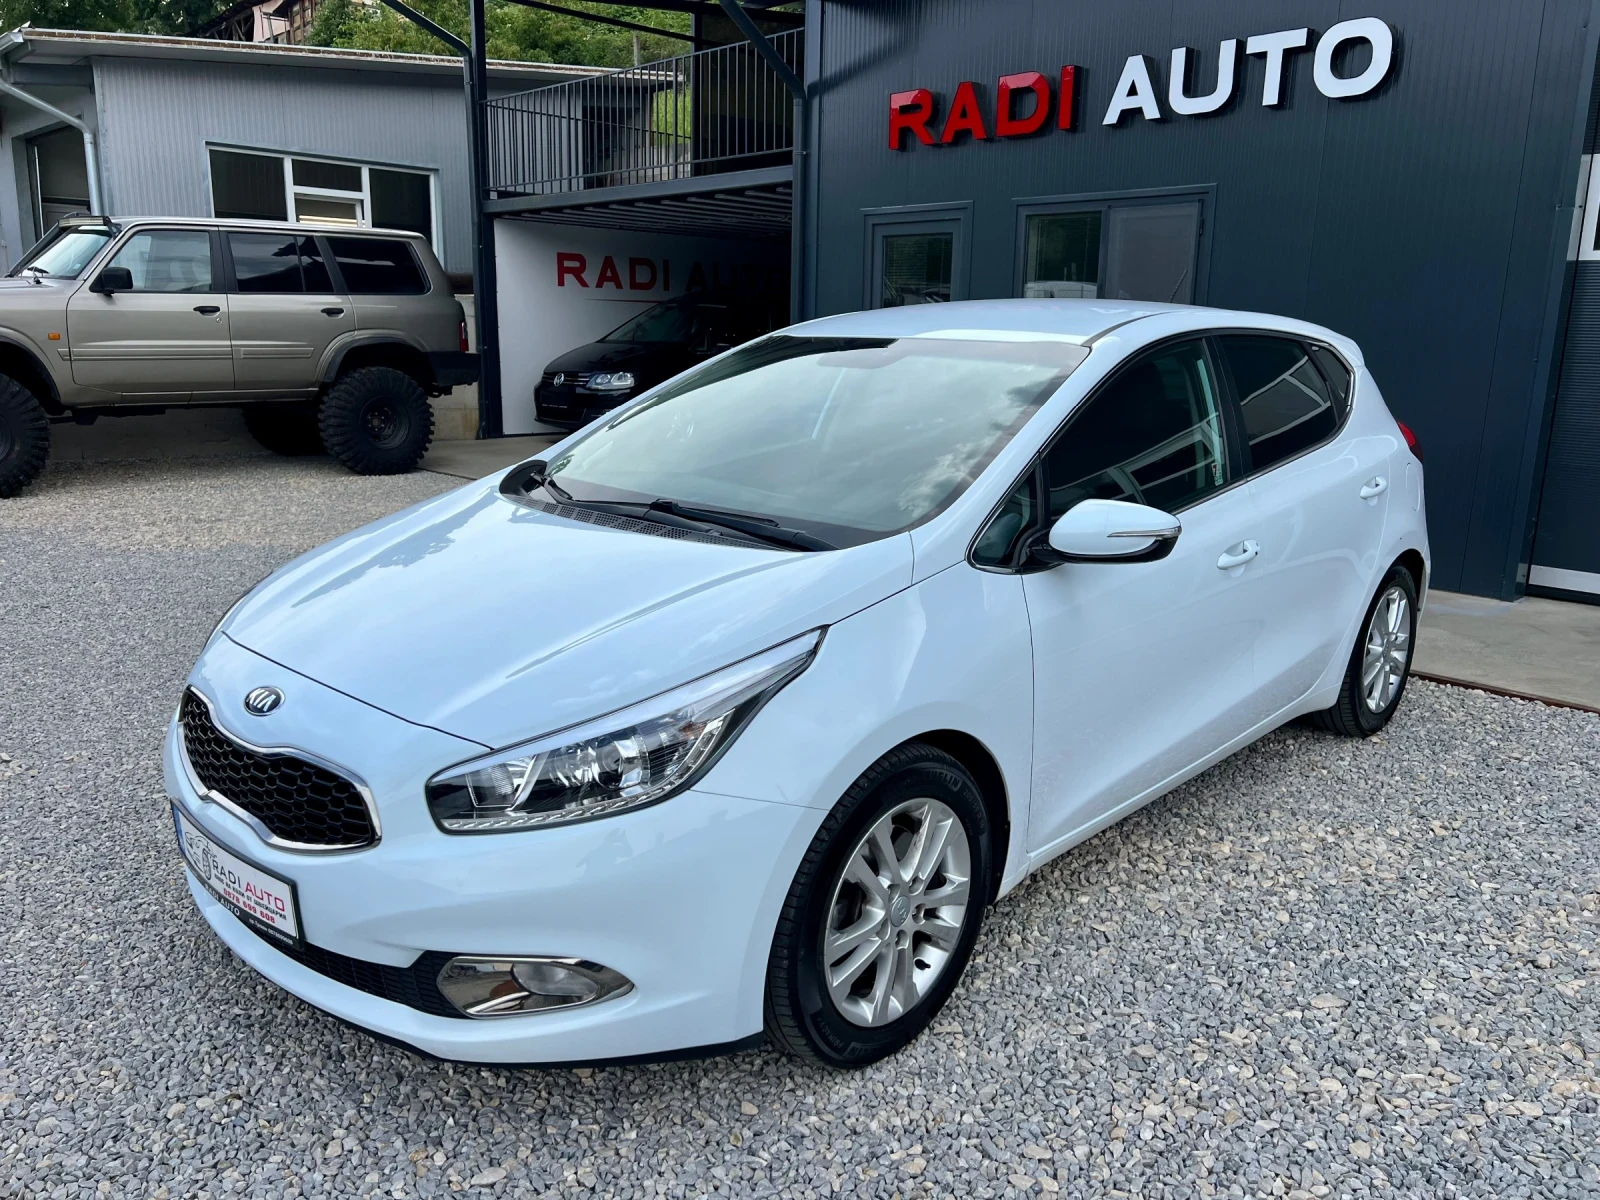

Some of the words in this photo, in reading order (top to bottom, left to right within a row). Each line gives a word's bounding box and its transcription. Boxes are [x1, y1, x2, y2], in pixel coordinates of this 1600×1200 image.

[888, 64, 1077, 151] RADI
[1102, 16, 1394, 127] AUTO
[556, 251, 671, 292] RADI
[204, 882, 219, 901] RADI
[220, 898, 240, 916] AUTO
[212, 858, 241, 889] RADI
[245, 881, 285, 912] AUTO
[223, 887, 241, 904] 0878
[818, 1019, 845, 1049] PRIMACY
